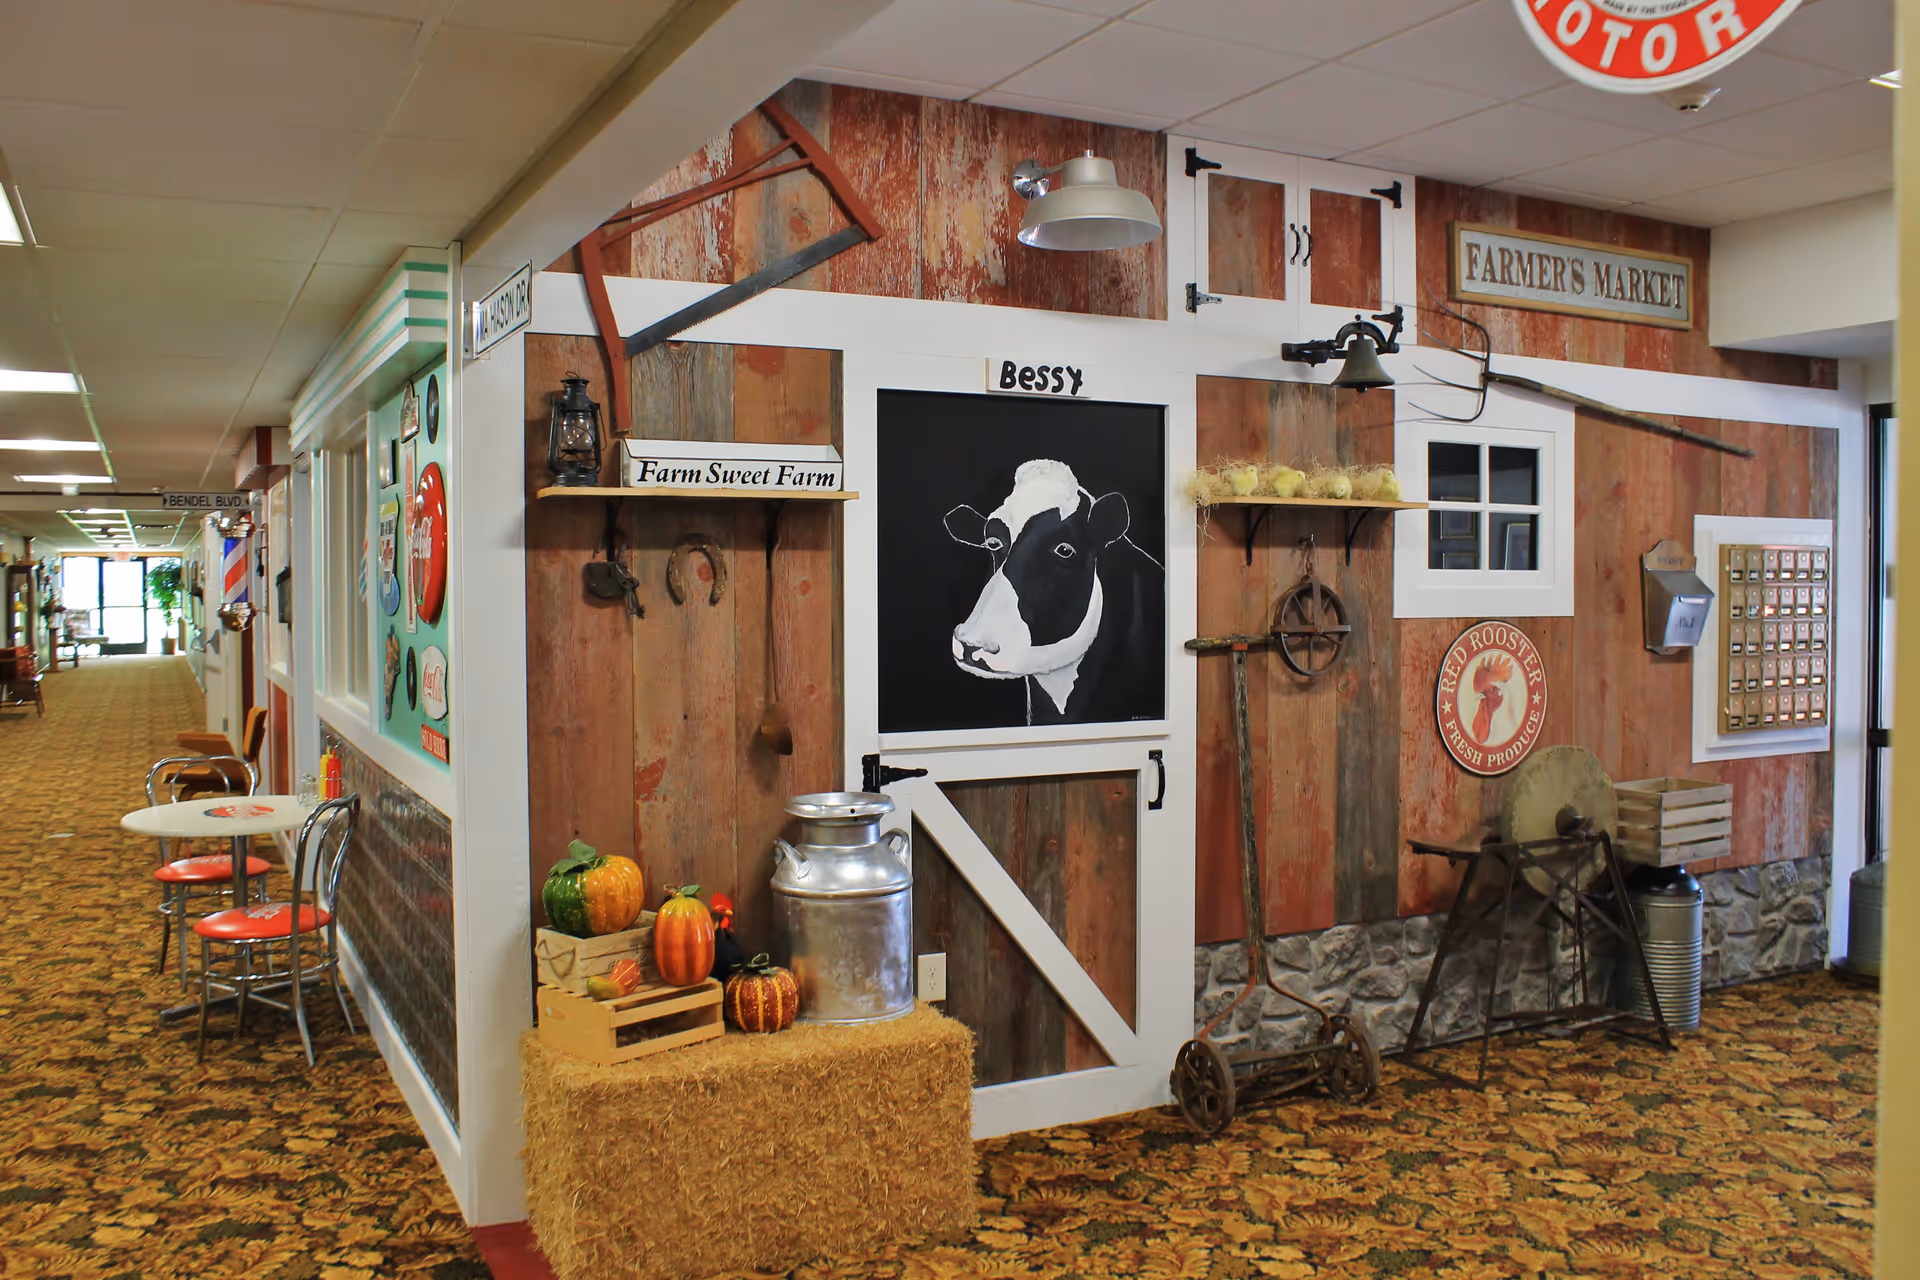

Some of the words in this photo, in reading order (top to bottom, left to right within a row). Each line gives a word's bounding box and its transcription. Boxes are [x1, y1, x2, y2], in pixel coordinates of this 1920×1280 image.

[1535, 0, 1748, 73] OTOR
[516, 279, 528, 318] DR.
[1463, 242, 1586, 296] FARMER'S
[1592, 261, 1686, 310] MARKET
[169, 495, 212, 507] BENDEL
[216, 495, 245, 508] BLVD.
[637, 459, 702, 484] Farm
[705, 461, 771, 485] Sweet
[775, 464, 836, 488] Farm
[1441, 646, 1468, 694] RED
[1469, 626, 1543, 687] ROOSTER
[1445, 718, 1484, 767] FRESH
[1487, 710, 1540, 768] PRODUCE
